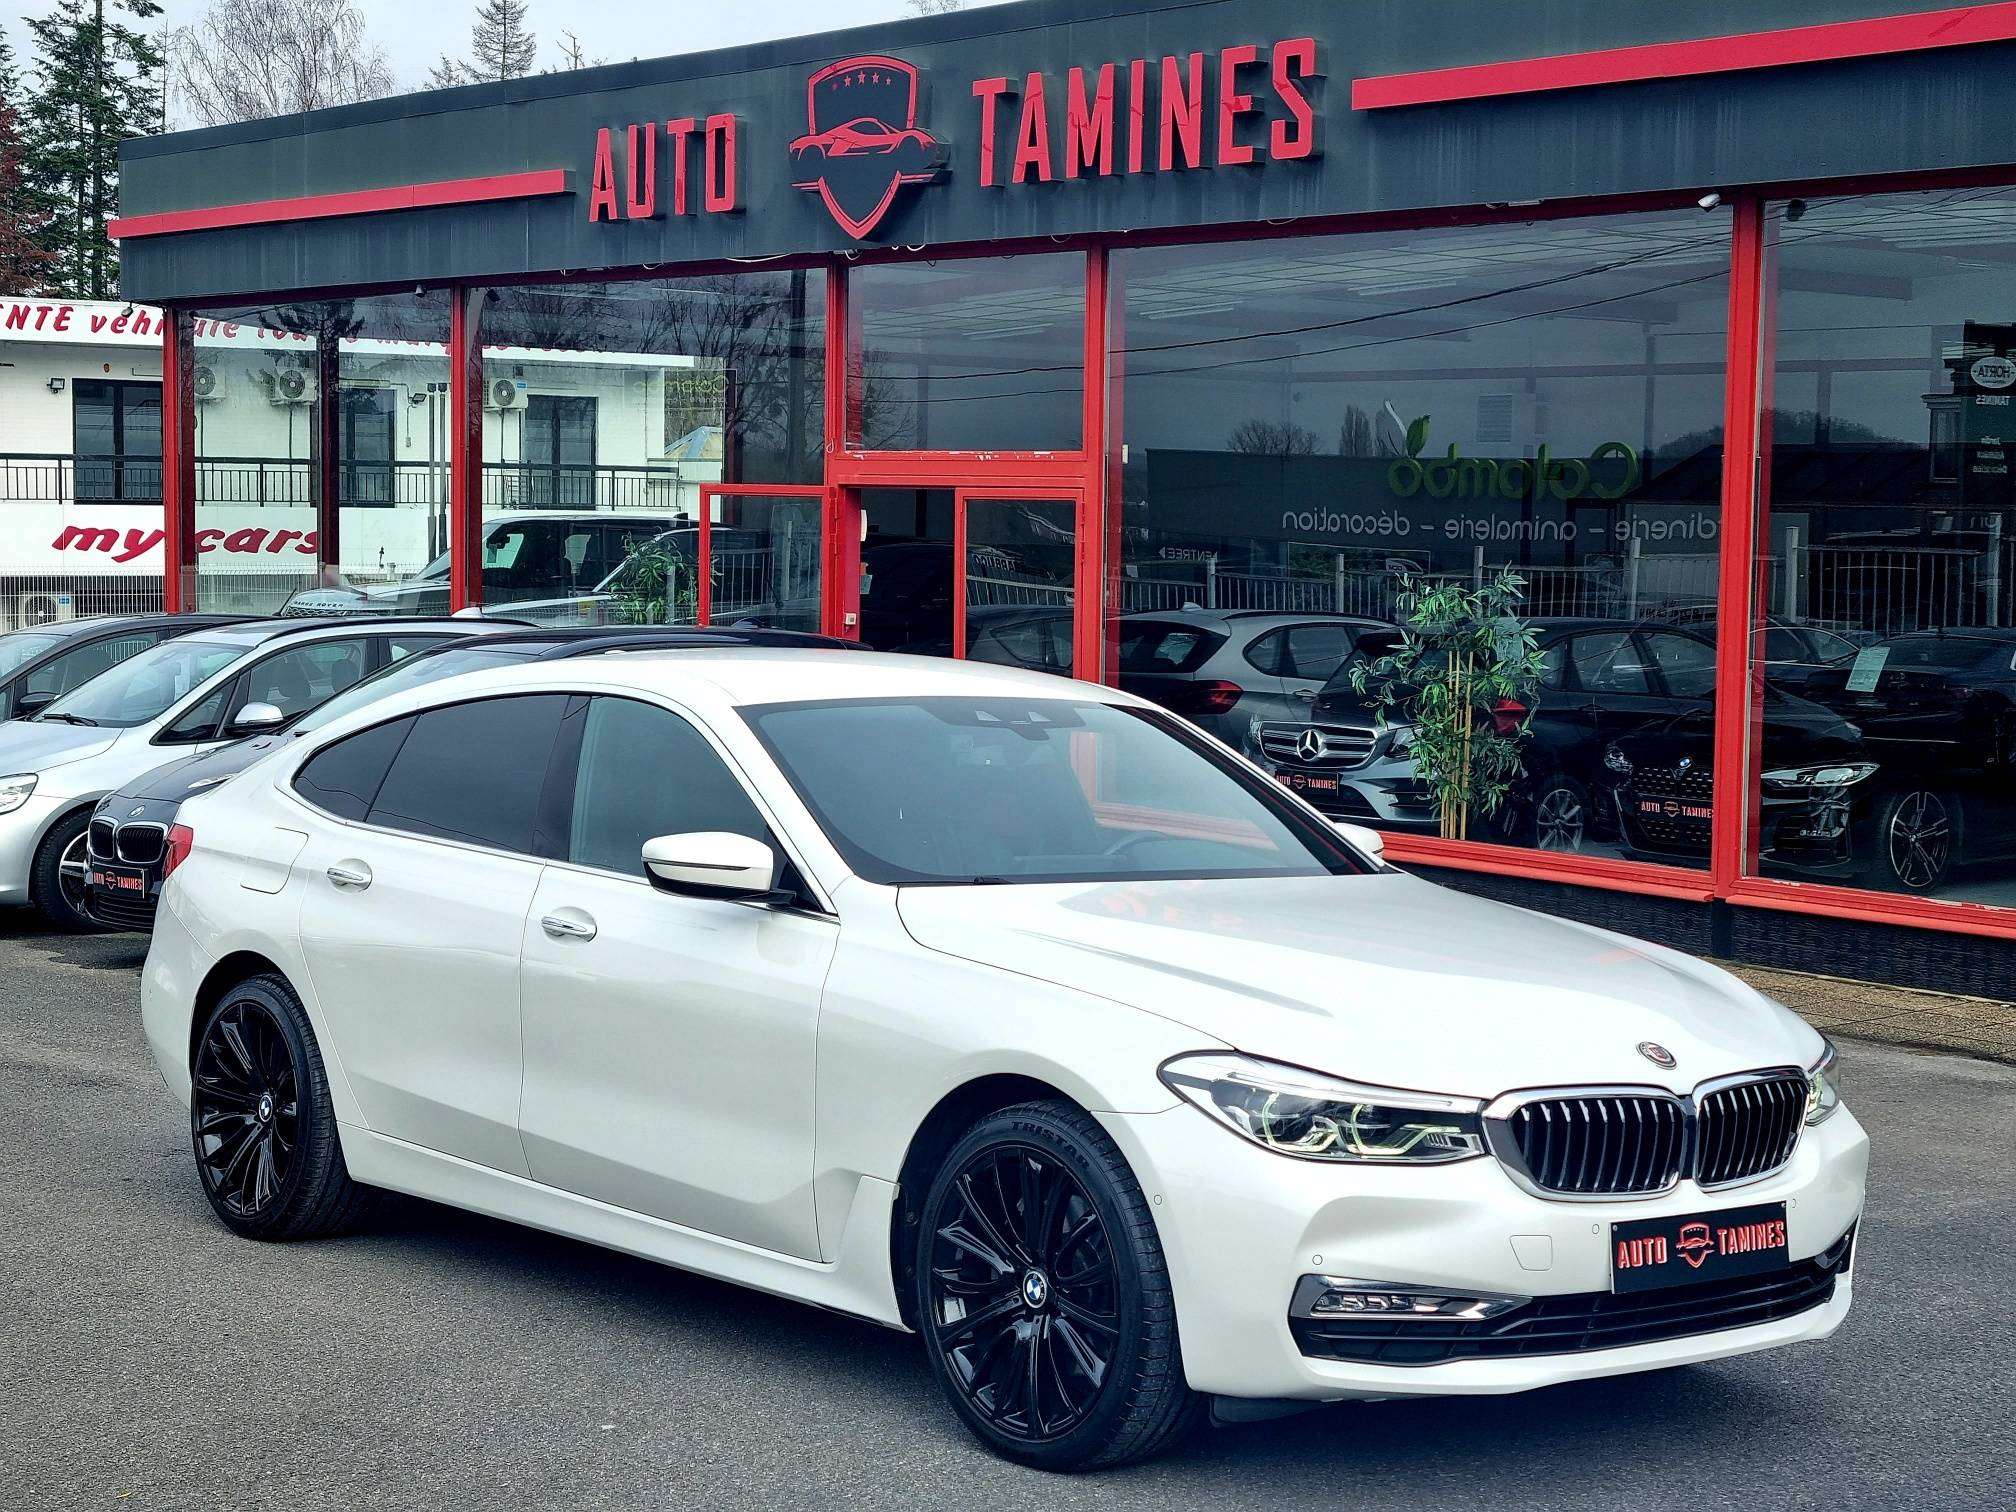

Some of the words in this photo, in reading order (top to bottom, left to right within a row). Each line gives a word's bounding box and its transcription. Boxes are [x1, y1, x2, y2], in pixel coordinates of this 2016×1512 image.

[589, 112, 736, 223] AUTO
[972, 38, 1316, 187] TAMINES
[52, 525, 165, 563] my
[195, 527, 319, 554] cars
[1307, 778, 1337, 790] TAMINES
[1641, 801, 1660, 813] AUTO
[1682, 805, 1714, 819] TAMINE
[116, 876, 143, 891] TAMINES
[1011, 1121, 1090, 1169] TRISTAR
[1617, 1236, 1668, 1269] AUTO
[1716, 1221, 1786, 1256] TAMINES
